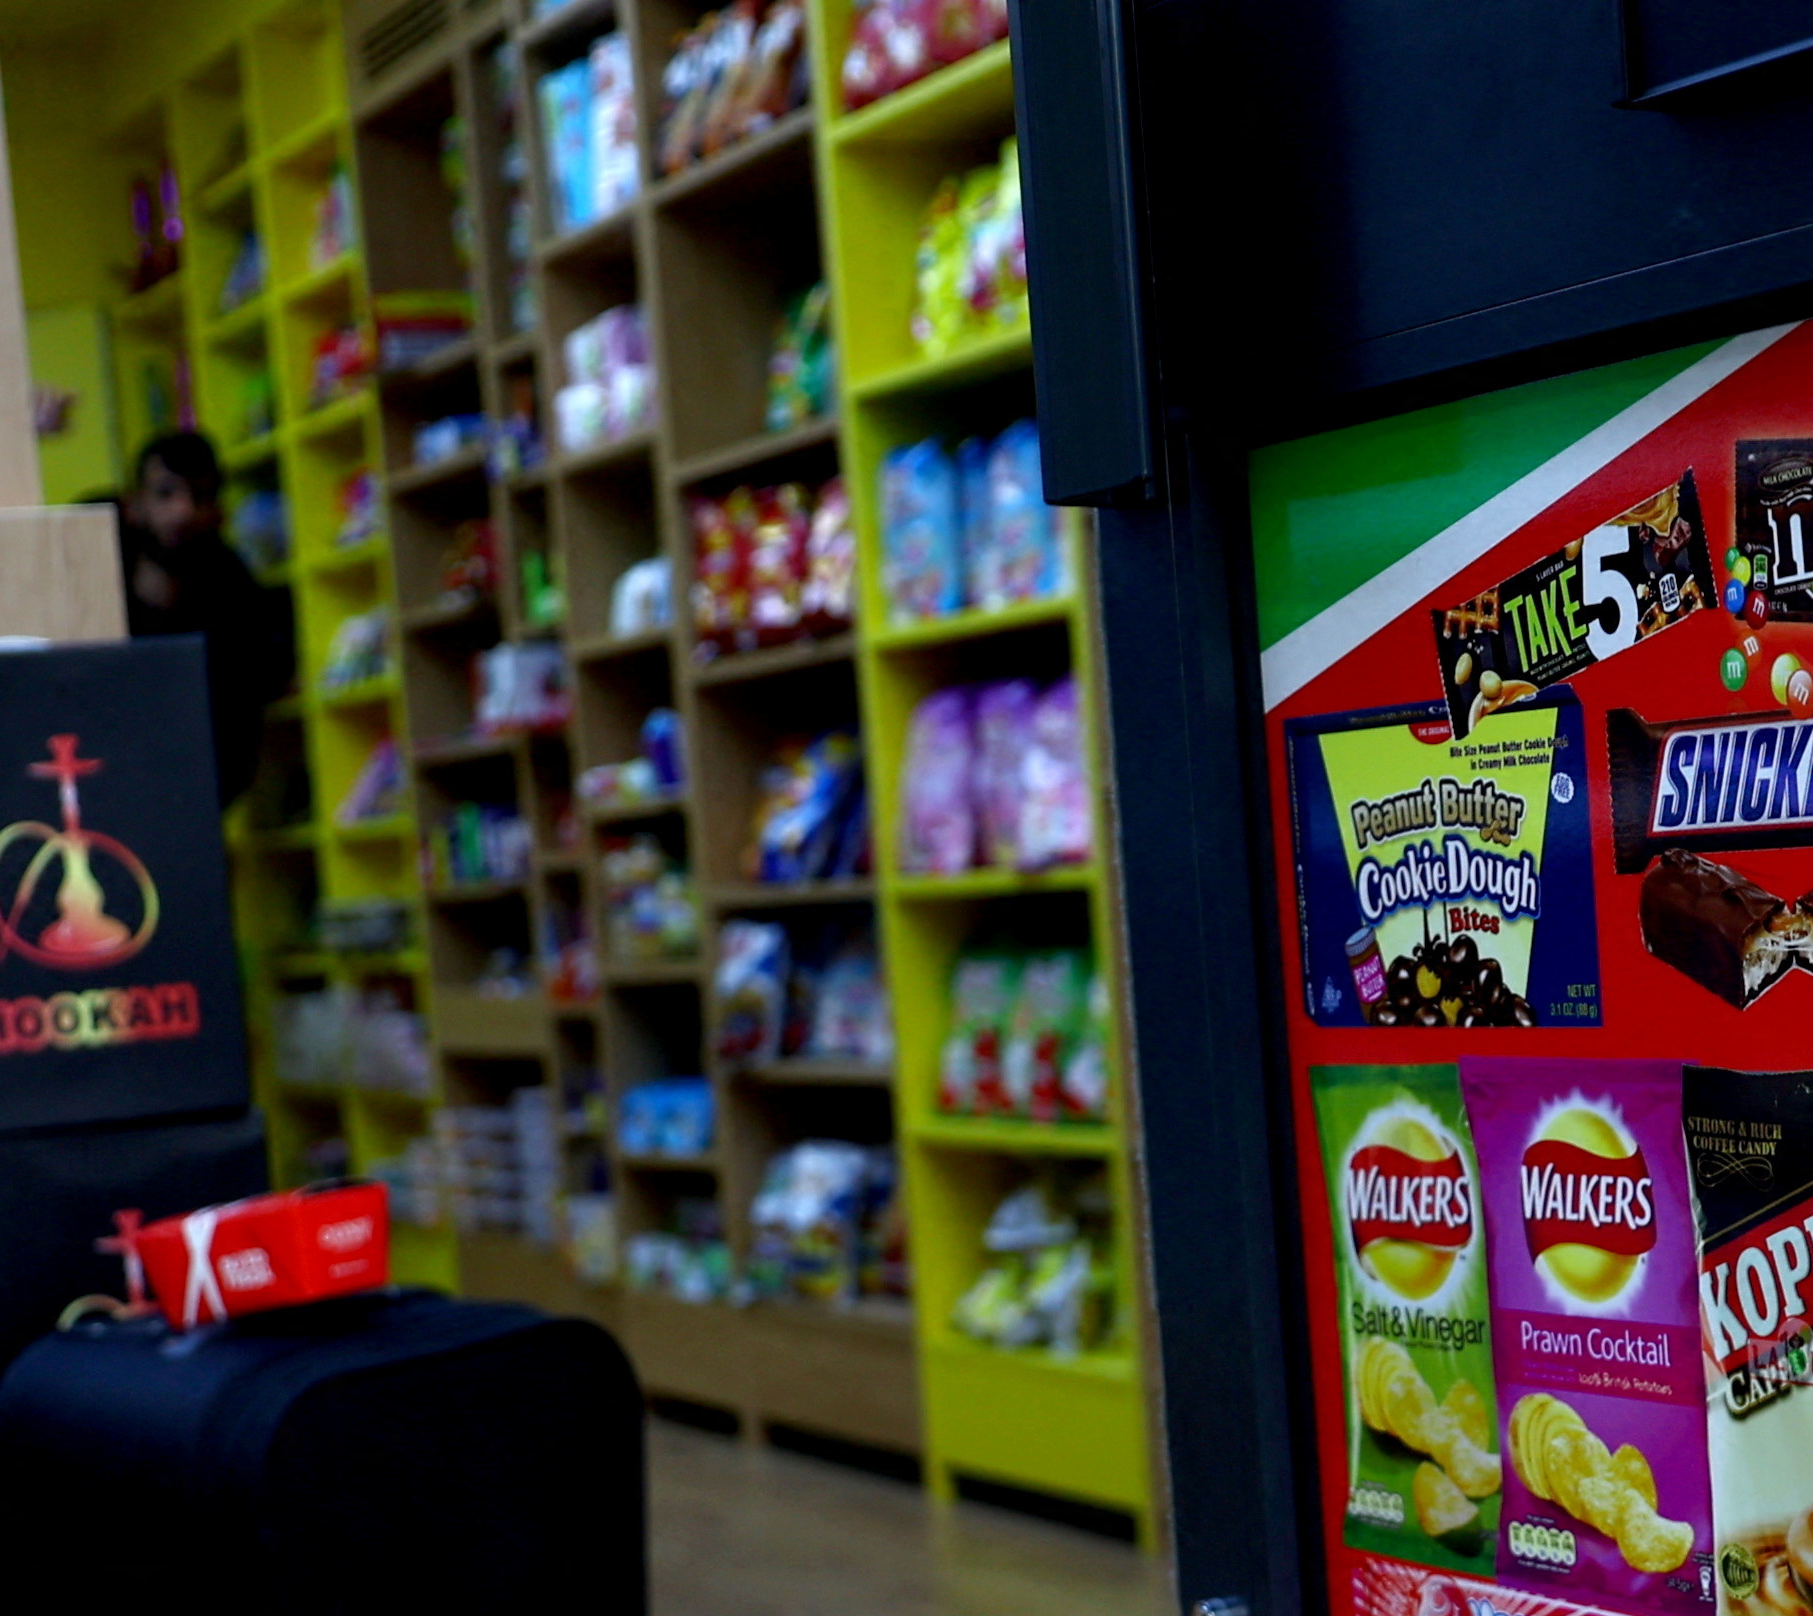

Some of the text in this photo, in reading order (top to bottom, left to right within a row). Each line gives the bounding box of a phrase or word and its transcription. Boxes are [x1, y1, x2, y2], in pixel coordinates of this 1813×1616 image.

[1781, 466, 1813, 481] CHOCOLATE
[1660, 576, 1676, 593] 210
[1504, 526, 1638, 673] TAKE 5
[1427, 726, 1450, 735] ORIGINAL
[1450, 735, 1568, 758] Bite Size Peanut Butter Cookie Dough
[1471, 752, 1550, 771] in Creamy Milk Chocolate
[1353, 781, 1523, 848] Peanut Butter
[1449, 908, 1500, 934] Bites
[1354, 955, 1382, 984] PEANUT
[1568, 985, 1596, 996] NET WT
[1688, 1116, 1783, 1141] STRONG & RICH
[1693, 1134, 1777, 1157] COFFEE CANDY
[1347, 1163, 1470, 1227] WALKERS
[1521, 1163, 1652, 1231] WALKERS
[1352, 1301, 1486, 1351] Salt & Vinegar
[1520, 1321, 1671, 1368] Prawn Cocktail
[1602, 1374, 1632, 1390] British
[1633, 1377, 1673, 1395] Potatoes
